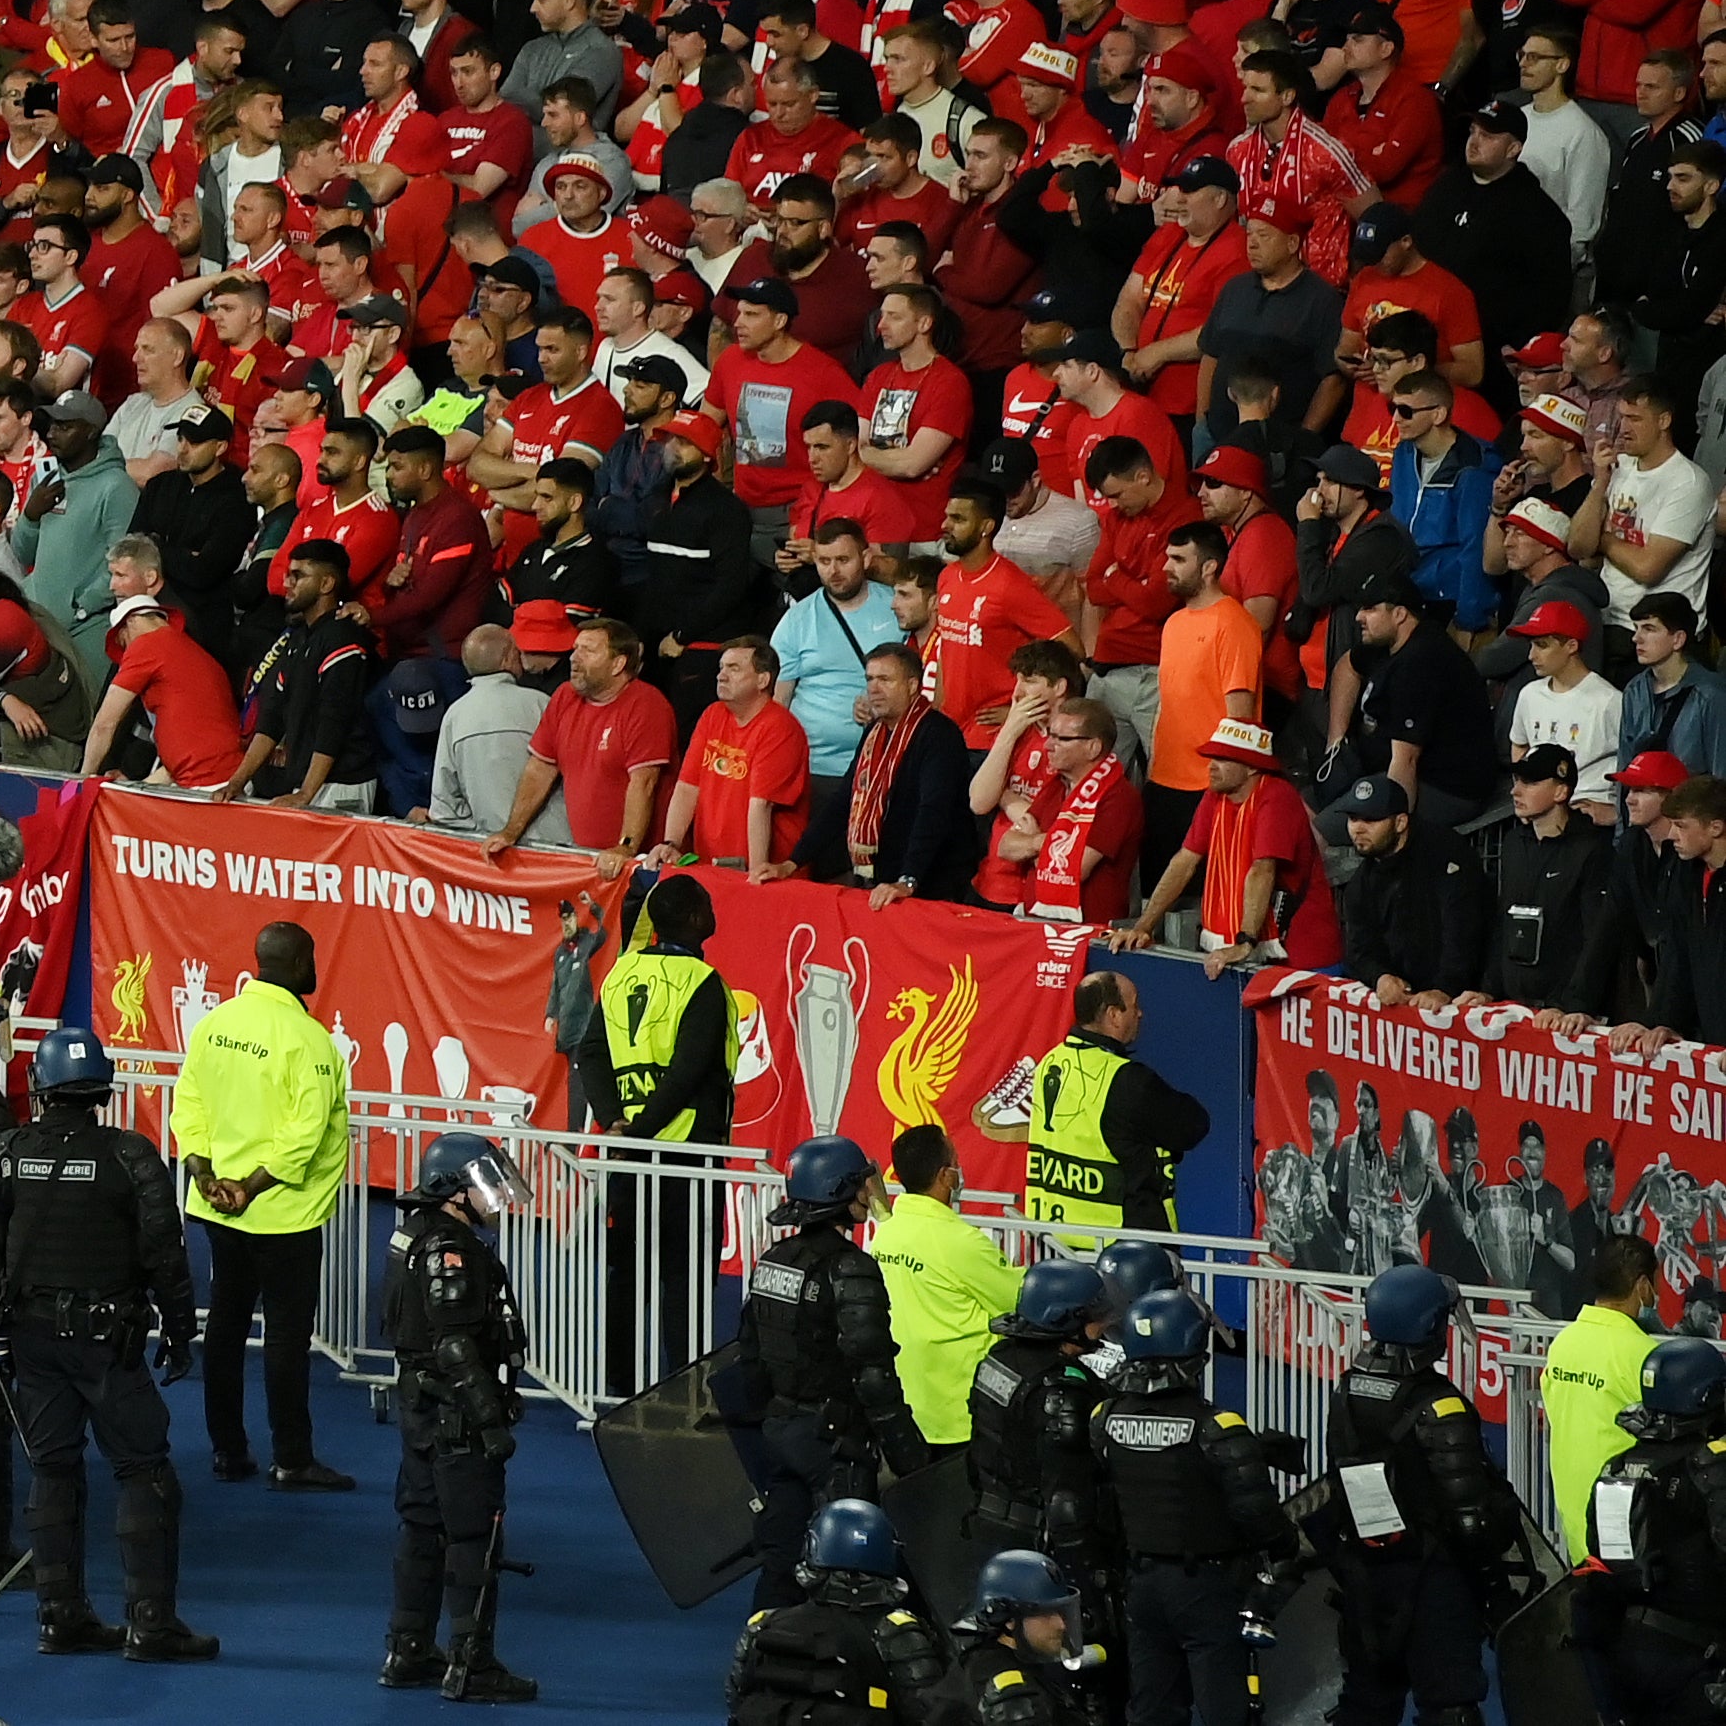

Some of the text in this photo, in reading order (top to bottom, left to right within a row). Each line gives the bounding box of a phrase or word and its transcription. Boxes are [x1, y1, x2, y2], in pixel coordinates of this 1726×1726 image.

[112, 834, 535, 935] TURNS WATER INTO WINE
[215, 1034, 270, 1060] Stand'Up
[1280, 995, 1314, 1049] HE
[1327, 1005, 1482, 1092] DELIVERED
[1497, 1047, 1598, 1115] WHAT
[1613, 1070, 1654, 1127] HE
[1551, 1366, 1606, 1390] Stand'Up
[1109, 1417, 1189, 1448] GENDARMERIE
